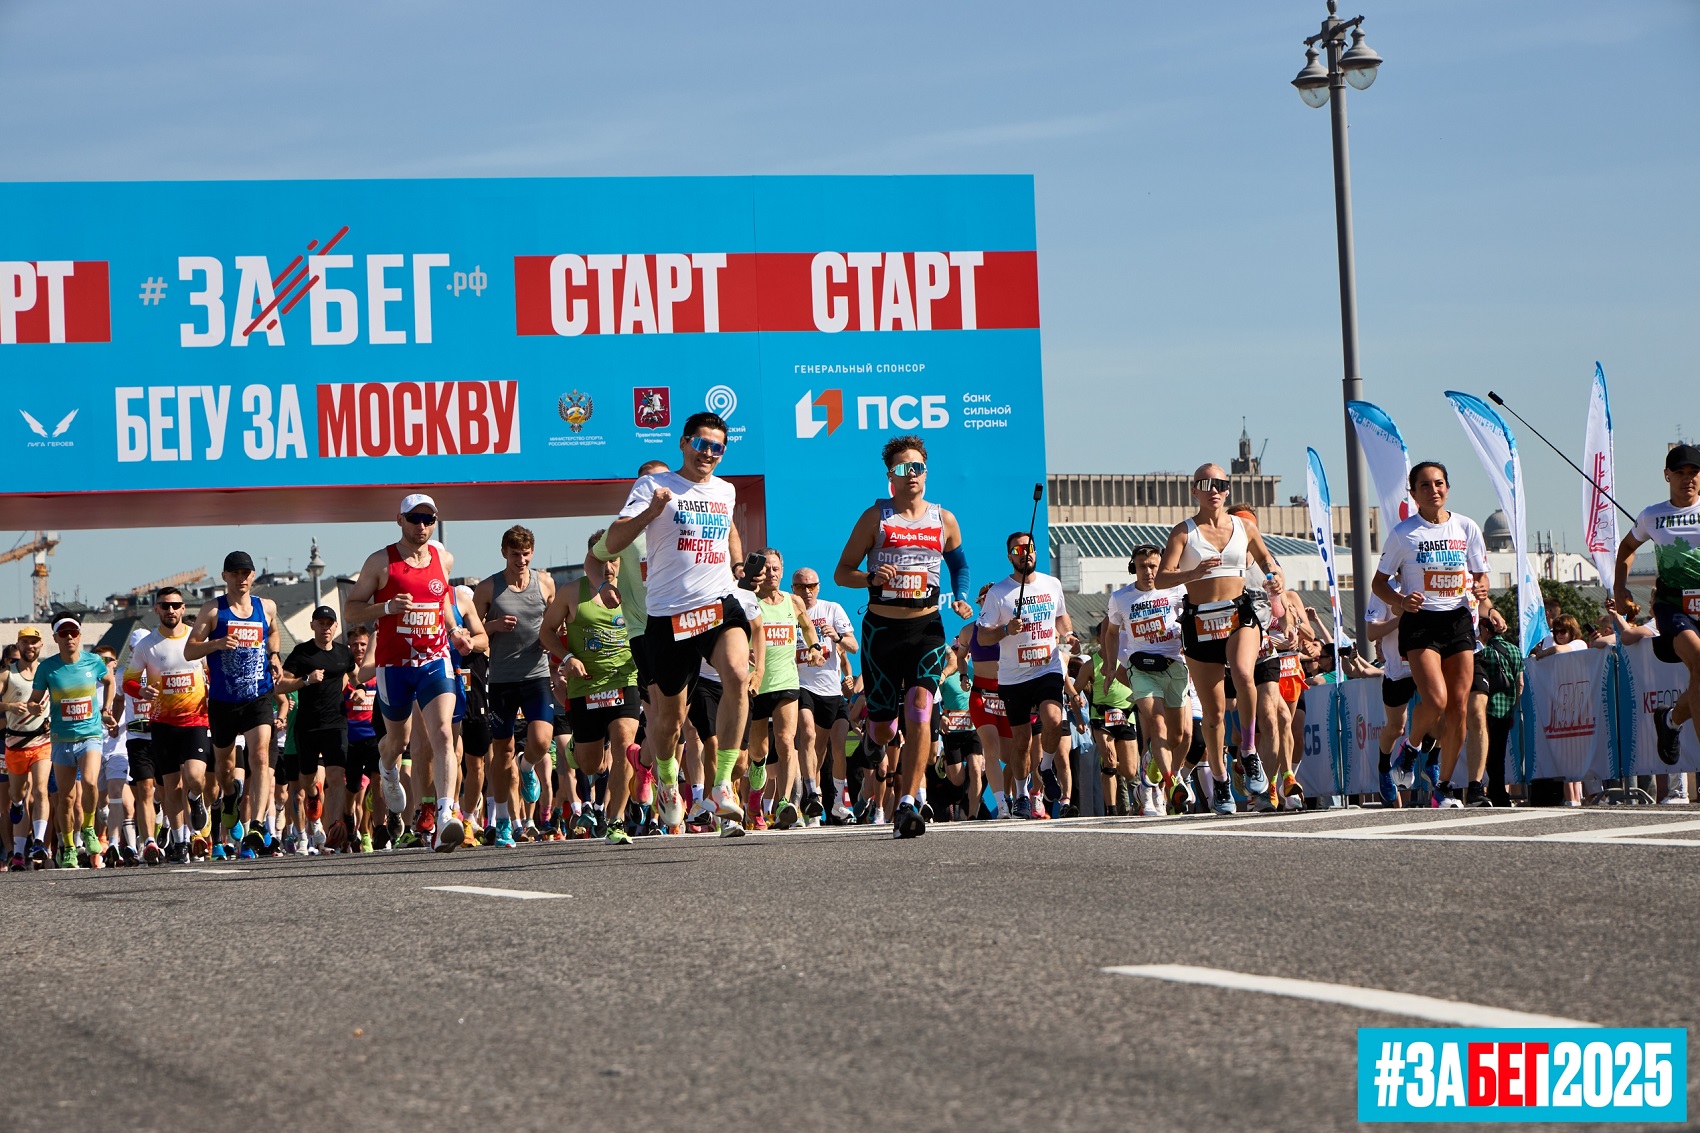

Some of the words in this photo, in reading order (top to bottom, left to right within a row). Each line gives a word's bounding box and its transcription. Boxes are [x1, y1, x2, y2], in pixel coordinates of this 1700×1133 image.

[549, 252, 727, 337] СТАРТ
[810, 250, 984, 334] СТАРТ
[794, 363, 873, 374] ГЕНЕРАЛЬНЫЙ
[876, 363, 926, 374] СПОНСОР
[963, 392, 991, 403] банк
[857, 395, 950, 430] ПСБ
[963, 404, 1012, 416] сильной
[114, 385, 231, 463] БЕГУ
[242, 384, 308, 460] ЗА
[317, 380, 518, 458] МОСКВУ
[963, 418, 1008, 430] страны
[673, 511, 695, 525] 45%
[1655, 513, 1700, 530] IZMYLO
[701, 526, 728, 540] БЕГУТ
[890, 531, 917, 542] Альфа
[917, 532, 938, 542] Банк
[677, 537, 714, 552] ВМЕСТЕ
[695, 552, 703, 565] С
[703, 551, 727, 565] ТОБОЙ
[1416, 551, 1434, 564] 45%
[888, 574, 922, 589] 42819
[1430, 573, 1464, 589] 45588
[402, 611, 436, 626] 40570
[679, 608, 717, 630] 46145
[1033, 611, 1052, 622] БЕГУТ
[766, 627, 790, 639] 41437
[165, 675, 192, 688] 43025
[1304, 724, 1321, 757] СБ
